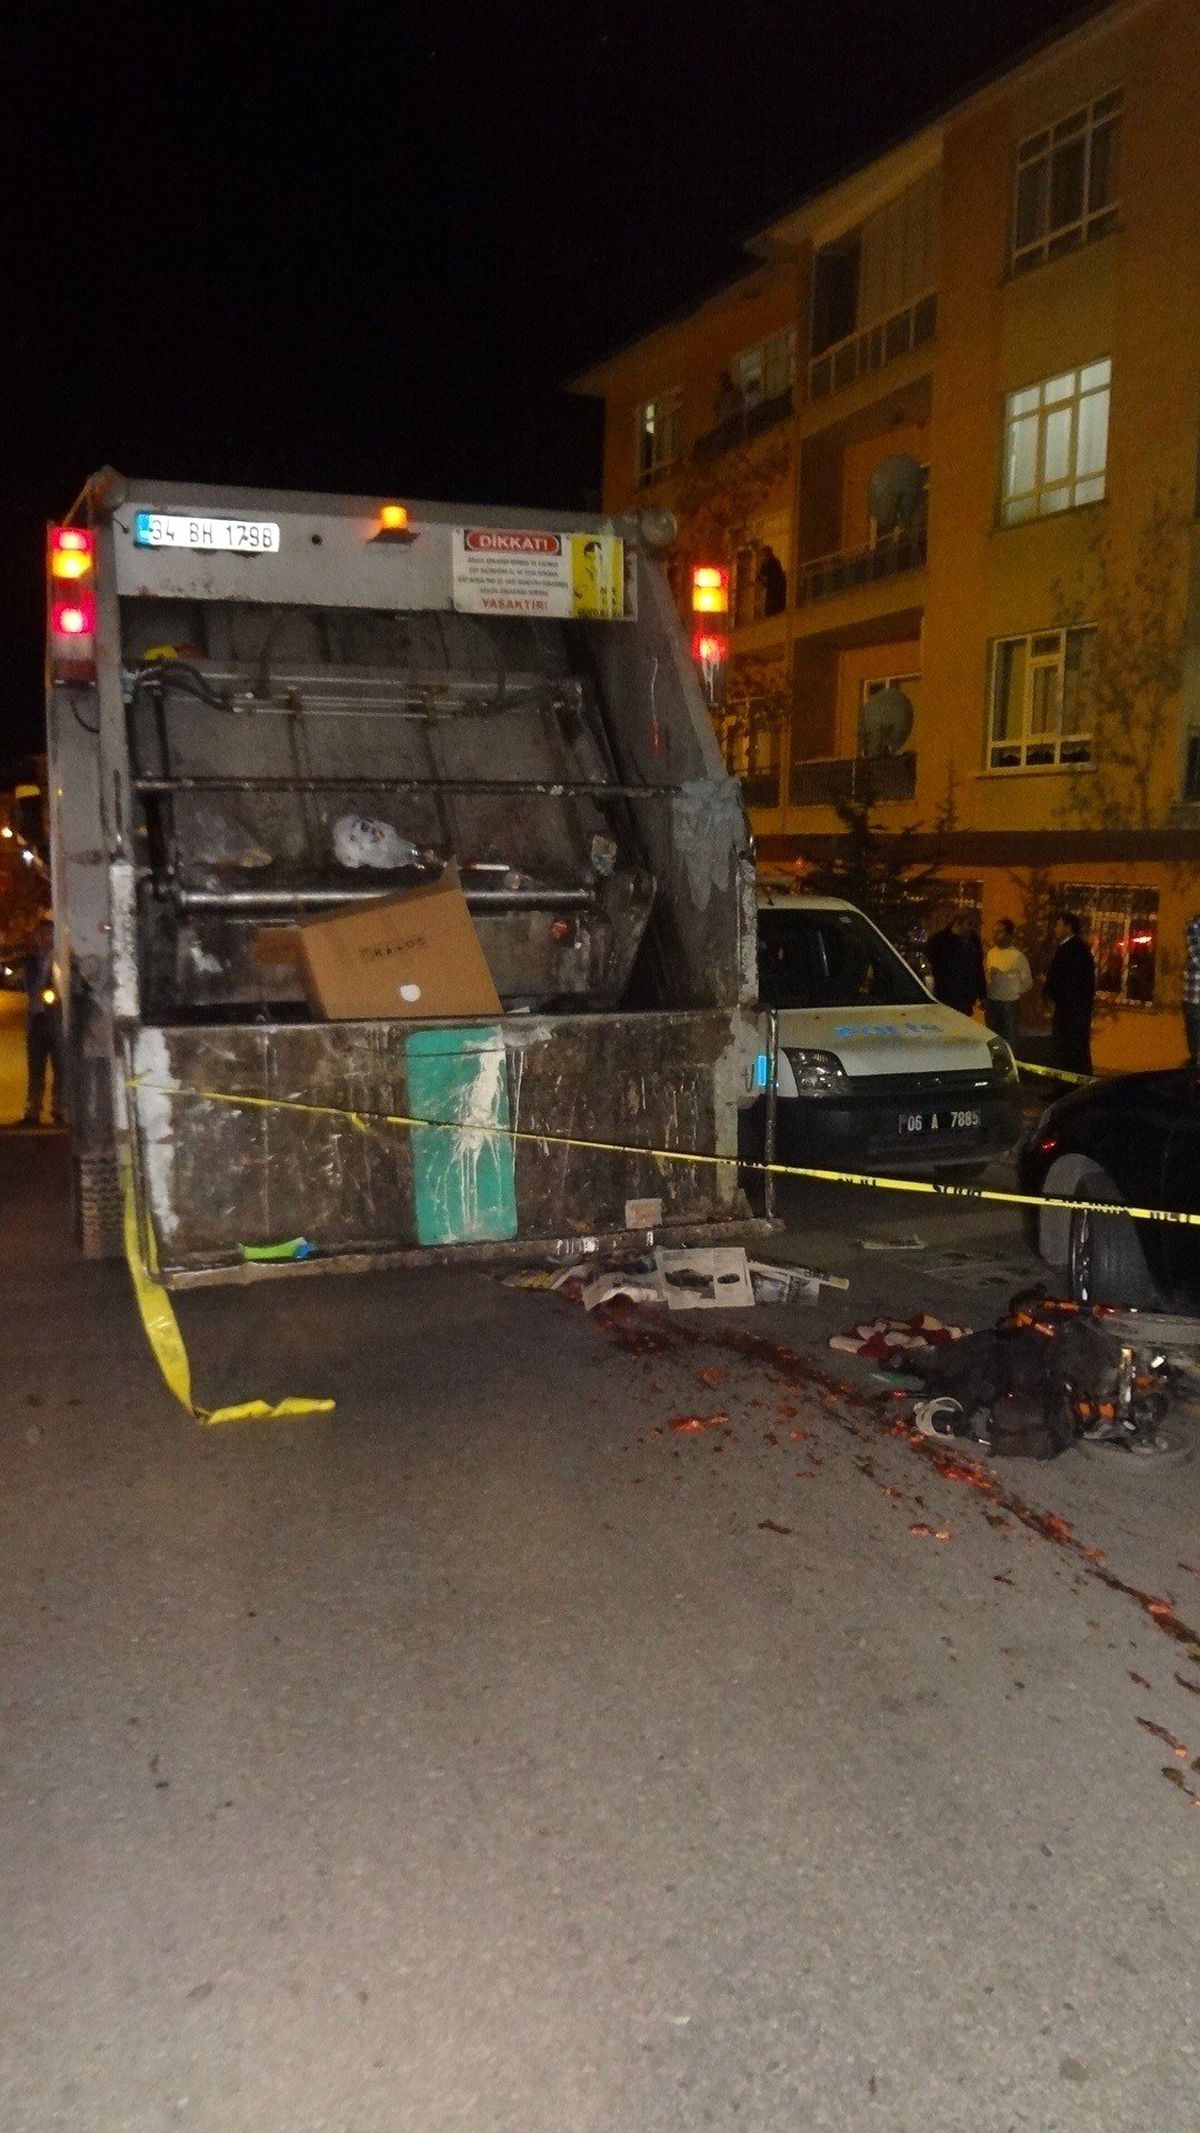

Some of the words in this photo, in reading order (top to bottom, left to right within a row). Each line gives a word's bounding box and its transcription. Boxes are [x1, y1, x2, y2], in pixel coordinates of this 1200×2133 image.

[151, 519, 175, 540] 34
[190, 522, 213, 543] BH
[907, 1115, 922, 1131] 06
[931, 1113, 938, 1129] A
